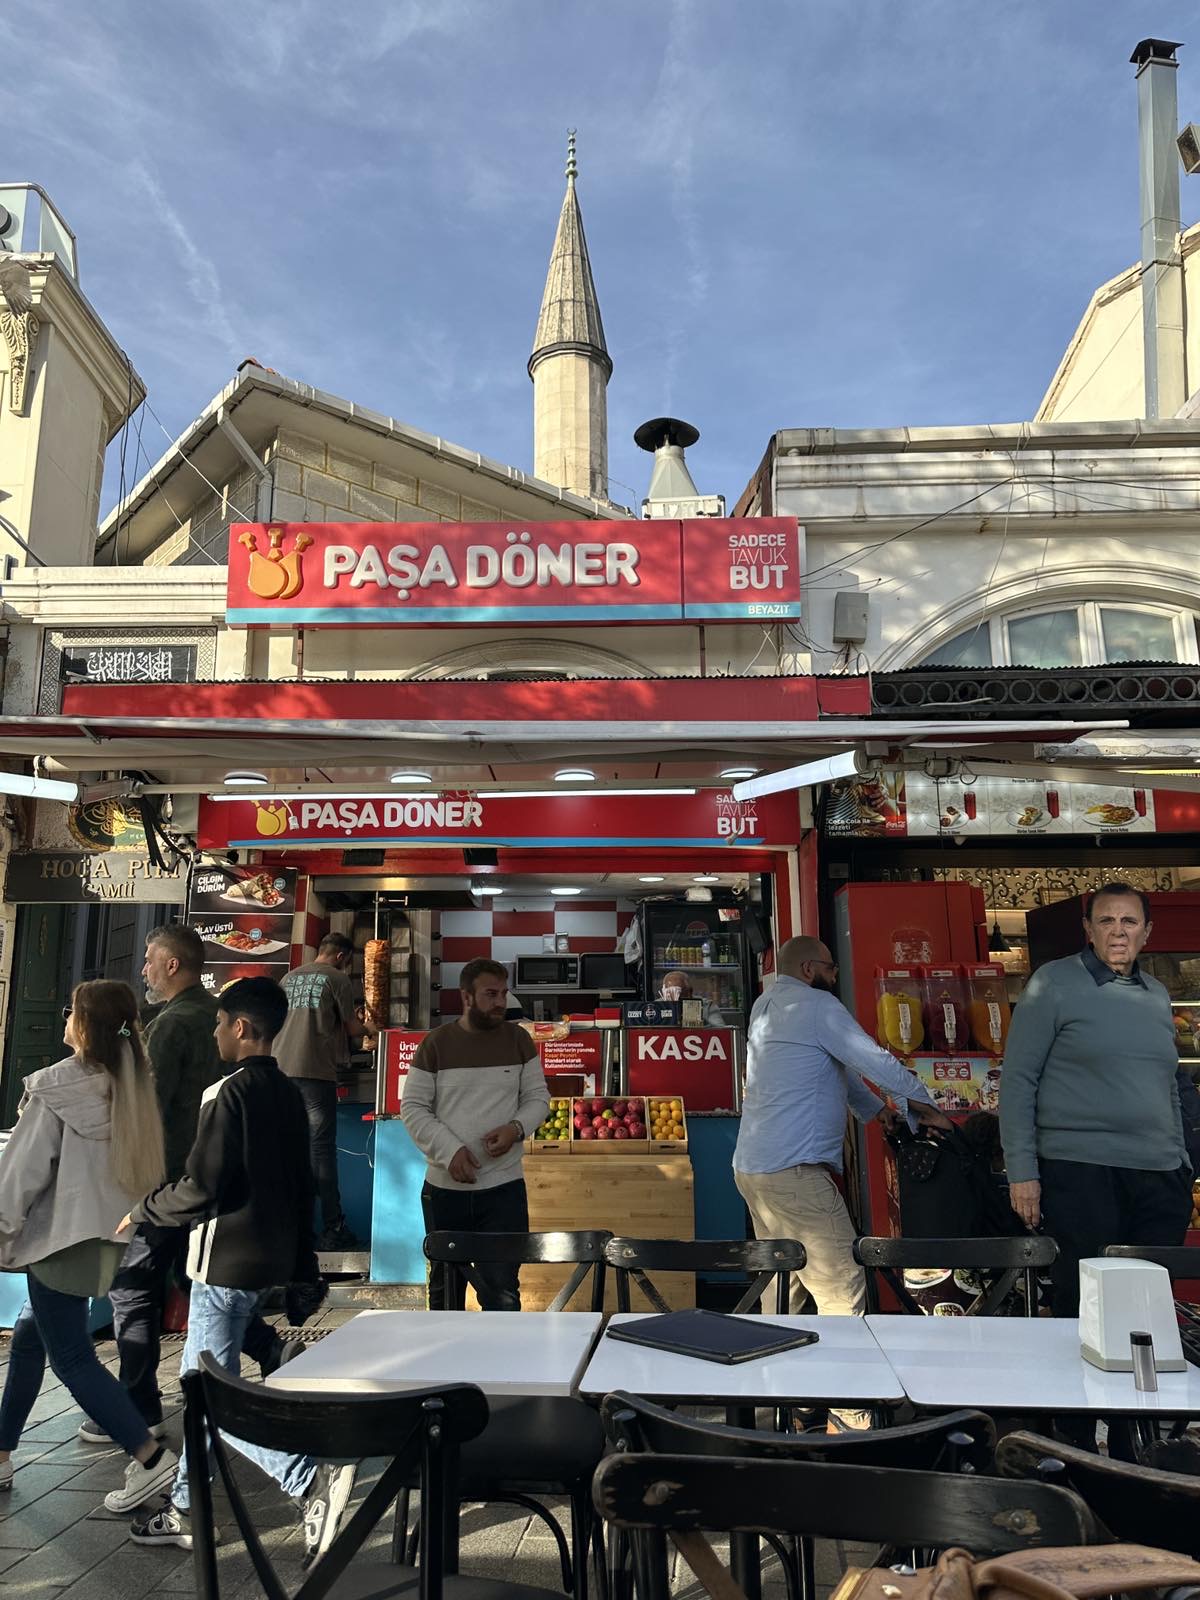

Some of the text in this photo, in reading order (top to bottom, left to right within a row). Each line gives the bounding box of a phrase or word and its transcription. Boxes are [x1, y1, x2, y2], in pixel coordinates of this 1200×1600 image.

[728, 533, 786, 548] SADECE
[323, 531, 641, 600] PAŞA DÖNER
[728, 547, 787, 566] TAVUK
[730, 564, 789, 590] BUT
[748, 605, 790, 615] BEYAZIT
[302, 801, 380, 835] PAŞA
[717, 817, 758, 835] BUT
[197, 882, 226, 893] DÜRÜM
[214, 921, 234, 932] ÜSTÜ
[638, 1035, 727, 1060] KASA
